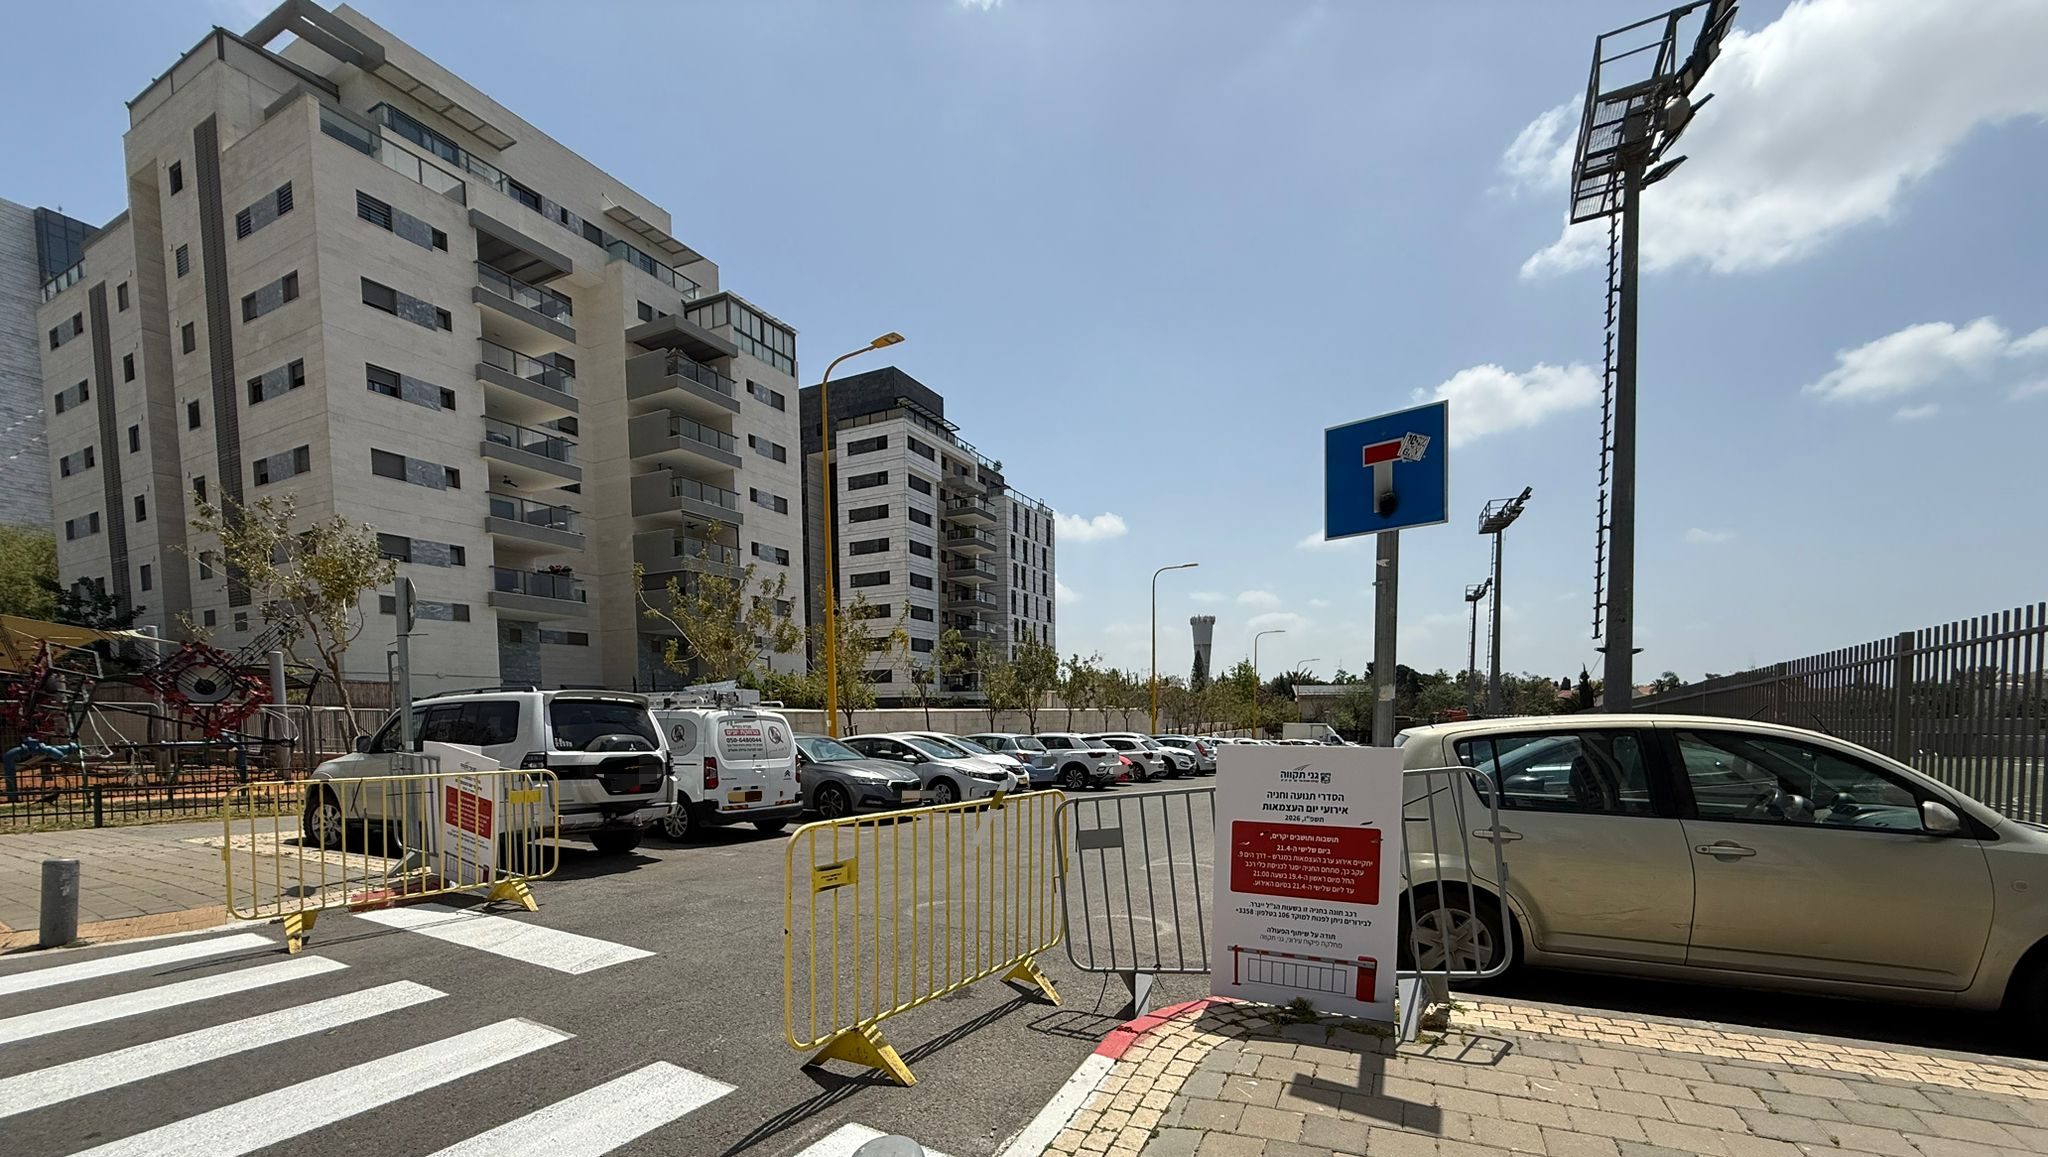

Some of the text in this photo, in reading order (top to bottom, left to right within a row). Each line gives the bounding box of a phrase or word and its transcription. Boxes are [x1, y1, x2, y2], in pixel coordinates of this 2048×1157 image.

[1280, 771, 1306, 780] תקווה
[1267, 791, 1344, 802] הסדרי תנועה וחניה
[1262, 803, 1304, 812] העצמאות
[1320, 806, 1348, 814] אירועי
